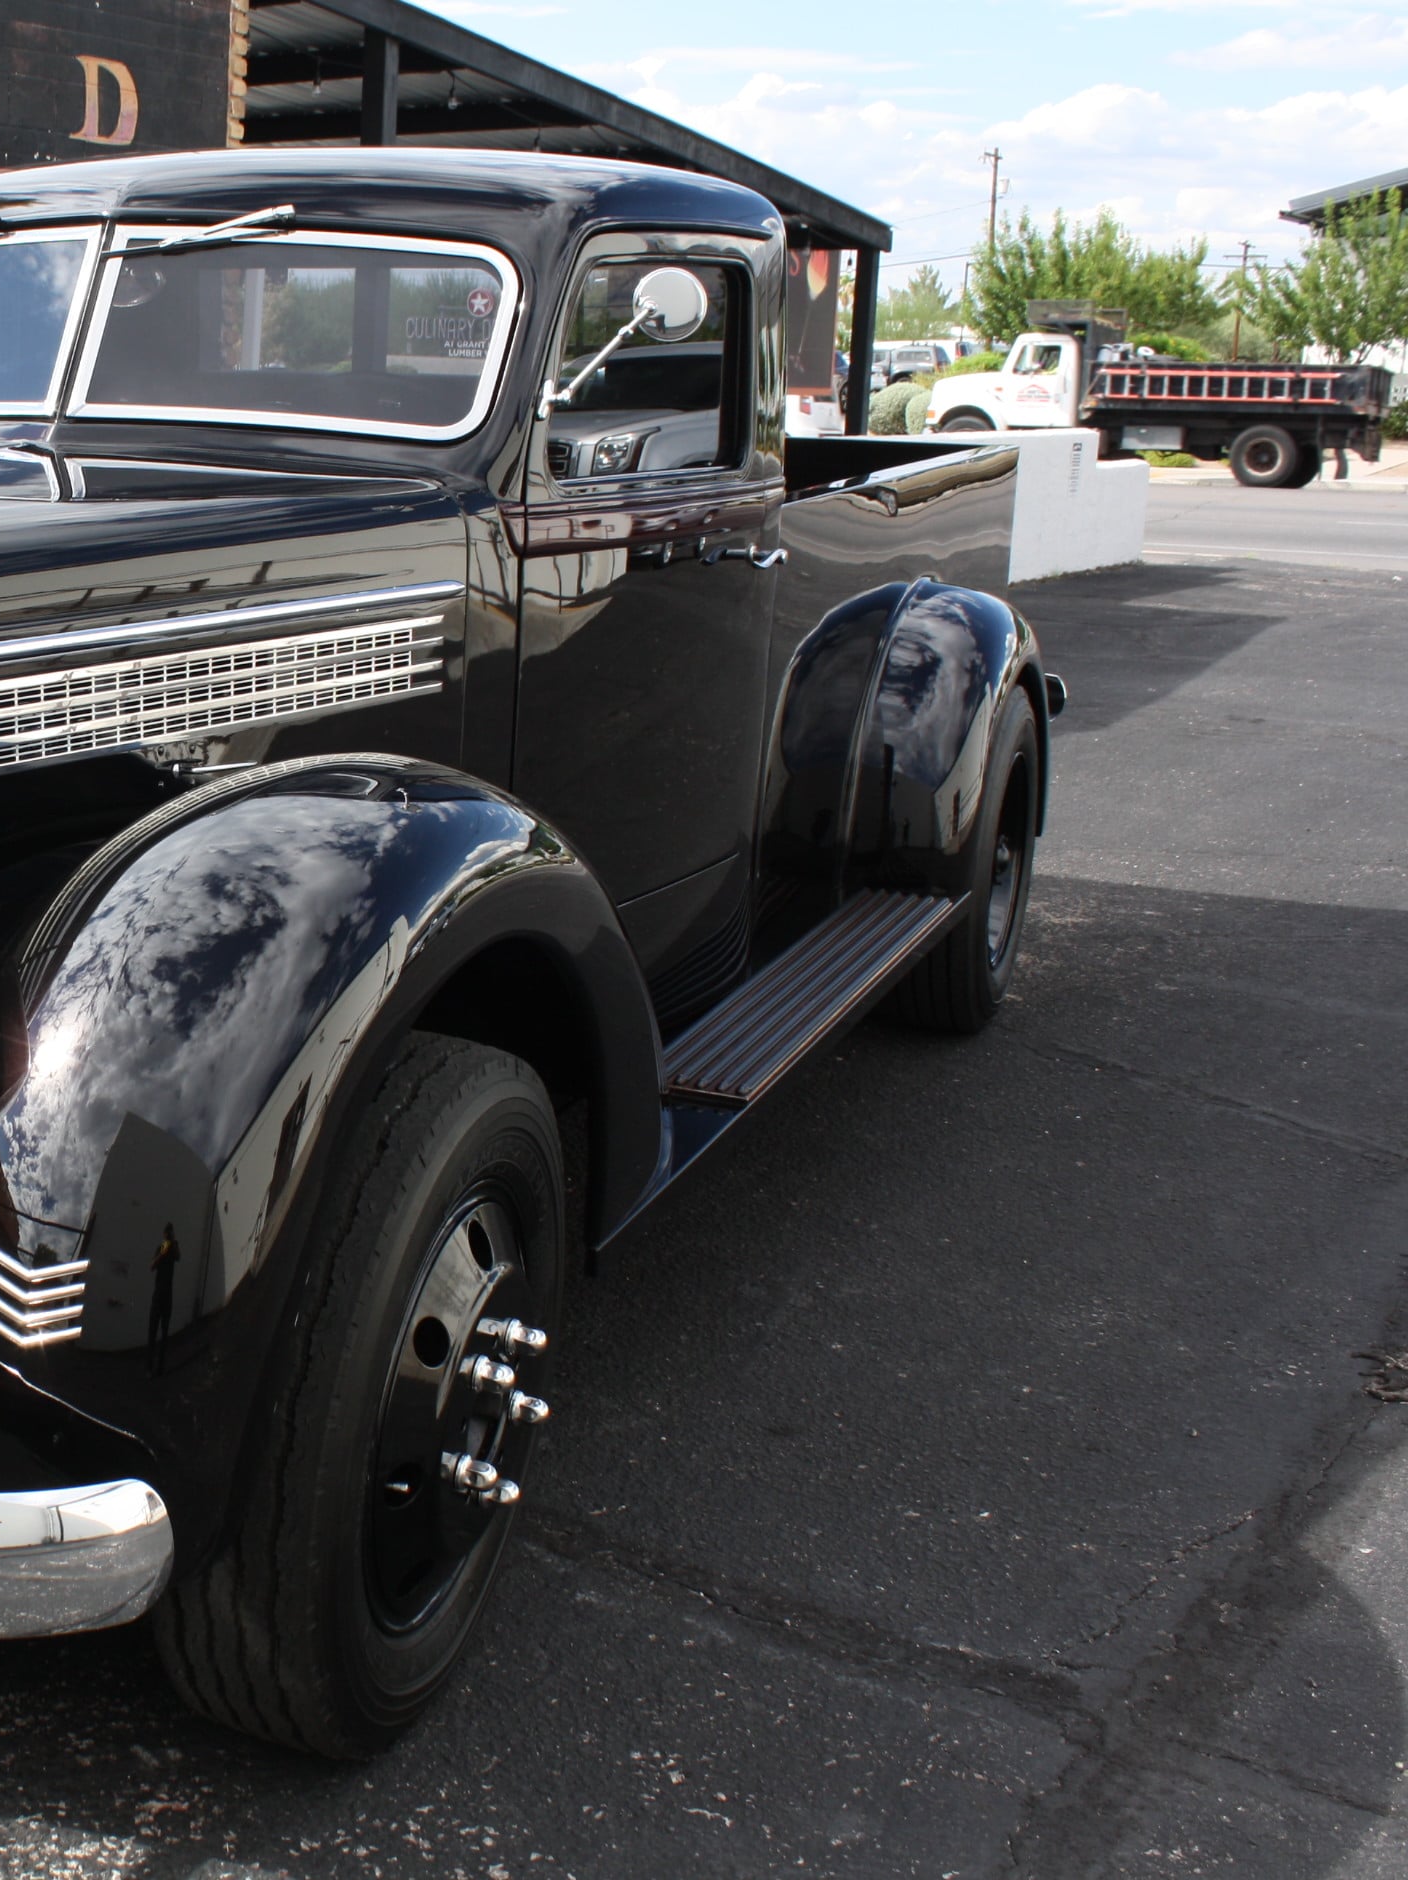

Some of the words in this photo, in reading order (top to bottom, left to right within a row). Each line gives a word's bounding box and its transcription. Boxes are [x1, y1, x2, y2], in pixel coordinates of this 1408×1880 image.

[69, 54, 139, 146] D
[406, 318, 475, 340] CULINARY
[448, 348, 482, 357] LUMBER
[457, 341, 485, 349] GRANT
